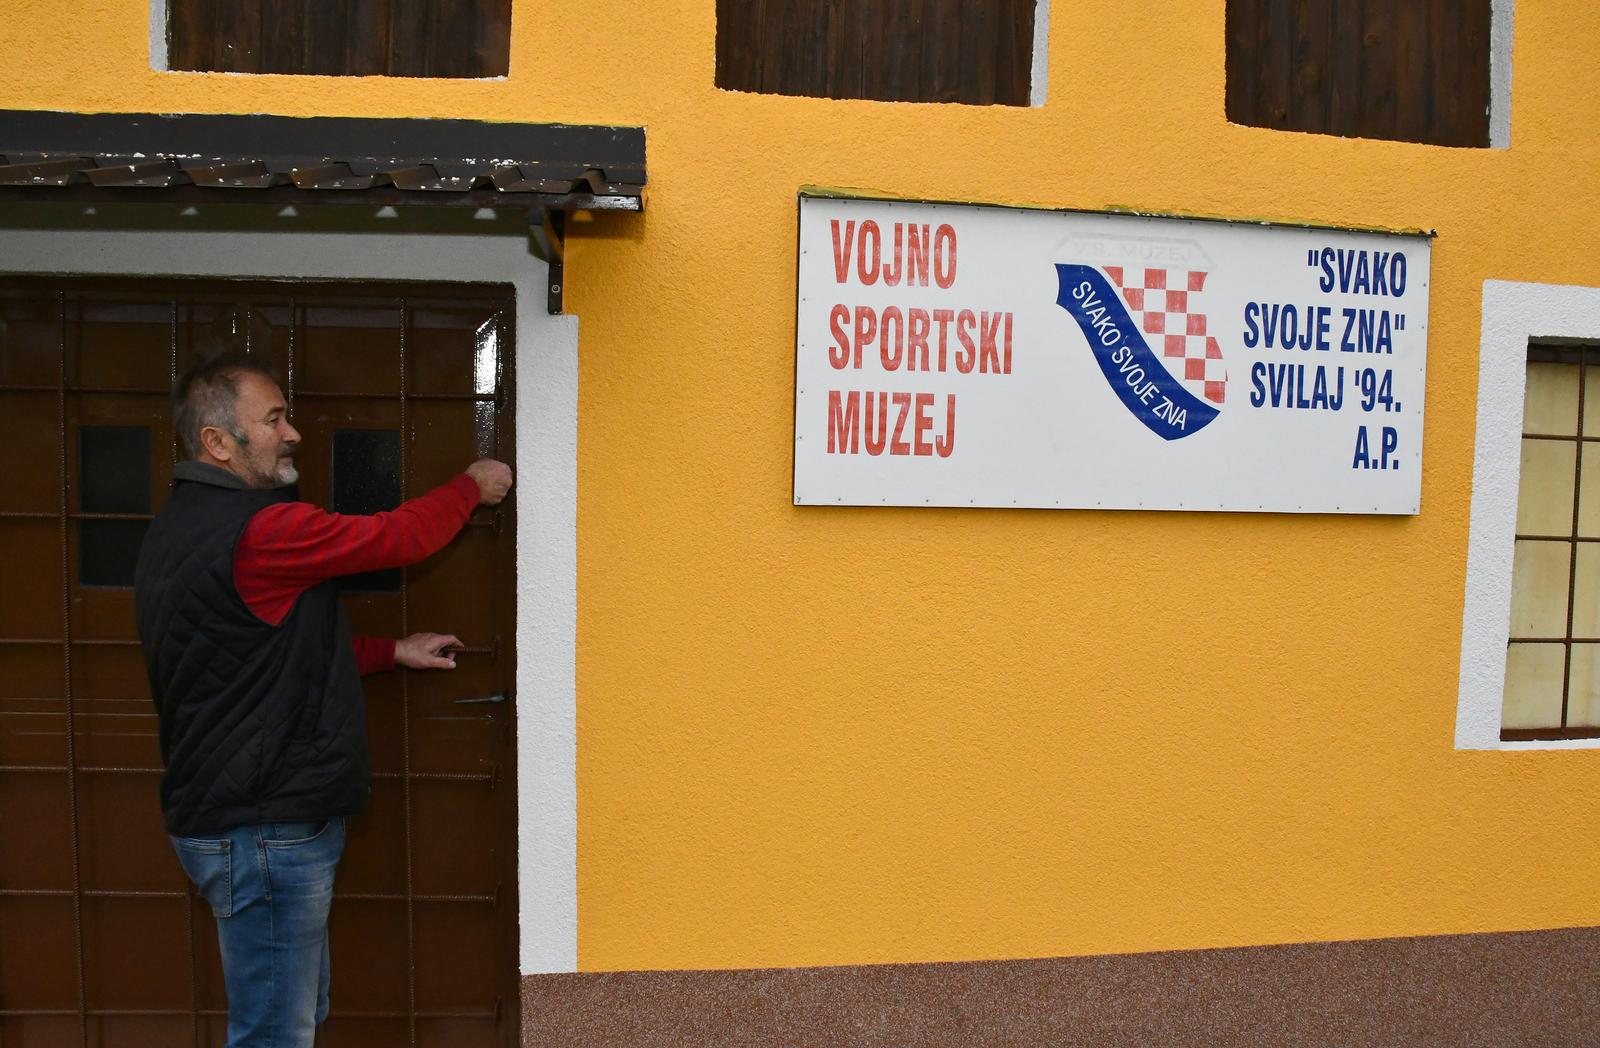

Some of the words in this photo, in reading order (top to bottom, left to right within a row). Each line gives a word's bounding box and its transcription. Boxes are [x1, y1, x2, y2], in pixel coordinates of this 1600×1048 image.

[830, 219, 957, 289] VOJNO
[1307, 246, 1407, 298] "SVAKO
[828, 303, 1013, 375] SPORTSKI
[1072, 281, 1121, 346] SVAKO
[1112, 346, 1159, 406] SVOJE
[1152, 395, 1188, 431] ZNA
[1243, 301, 1332, 352] SVOJE
[1340, 308, 1406, 354] ZNA"
[1250, 361, 1345, 411] SVILAJ
[826, 390, 957, 458] MUZEJ
[1352, 425, 1400, 470] A.P.
